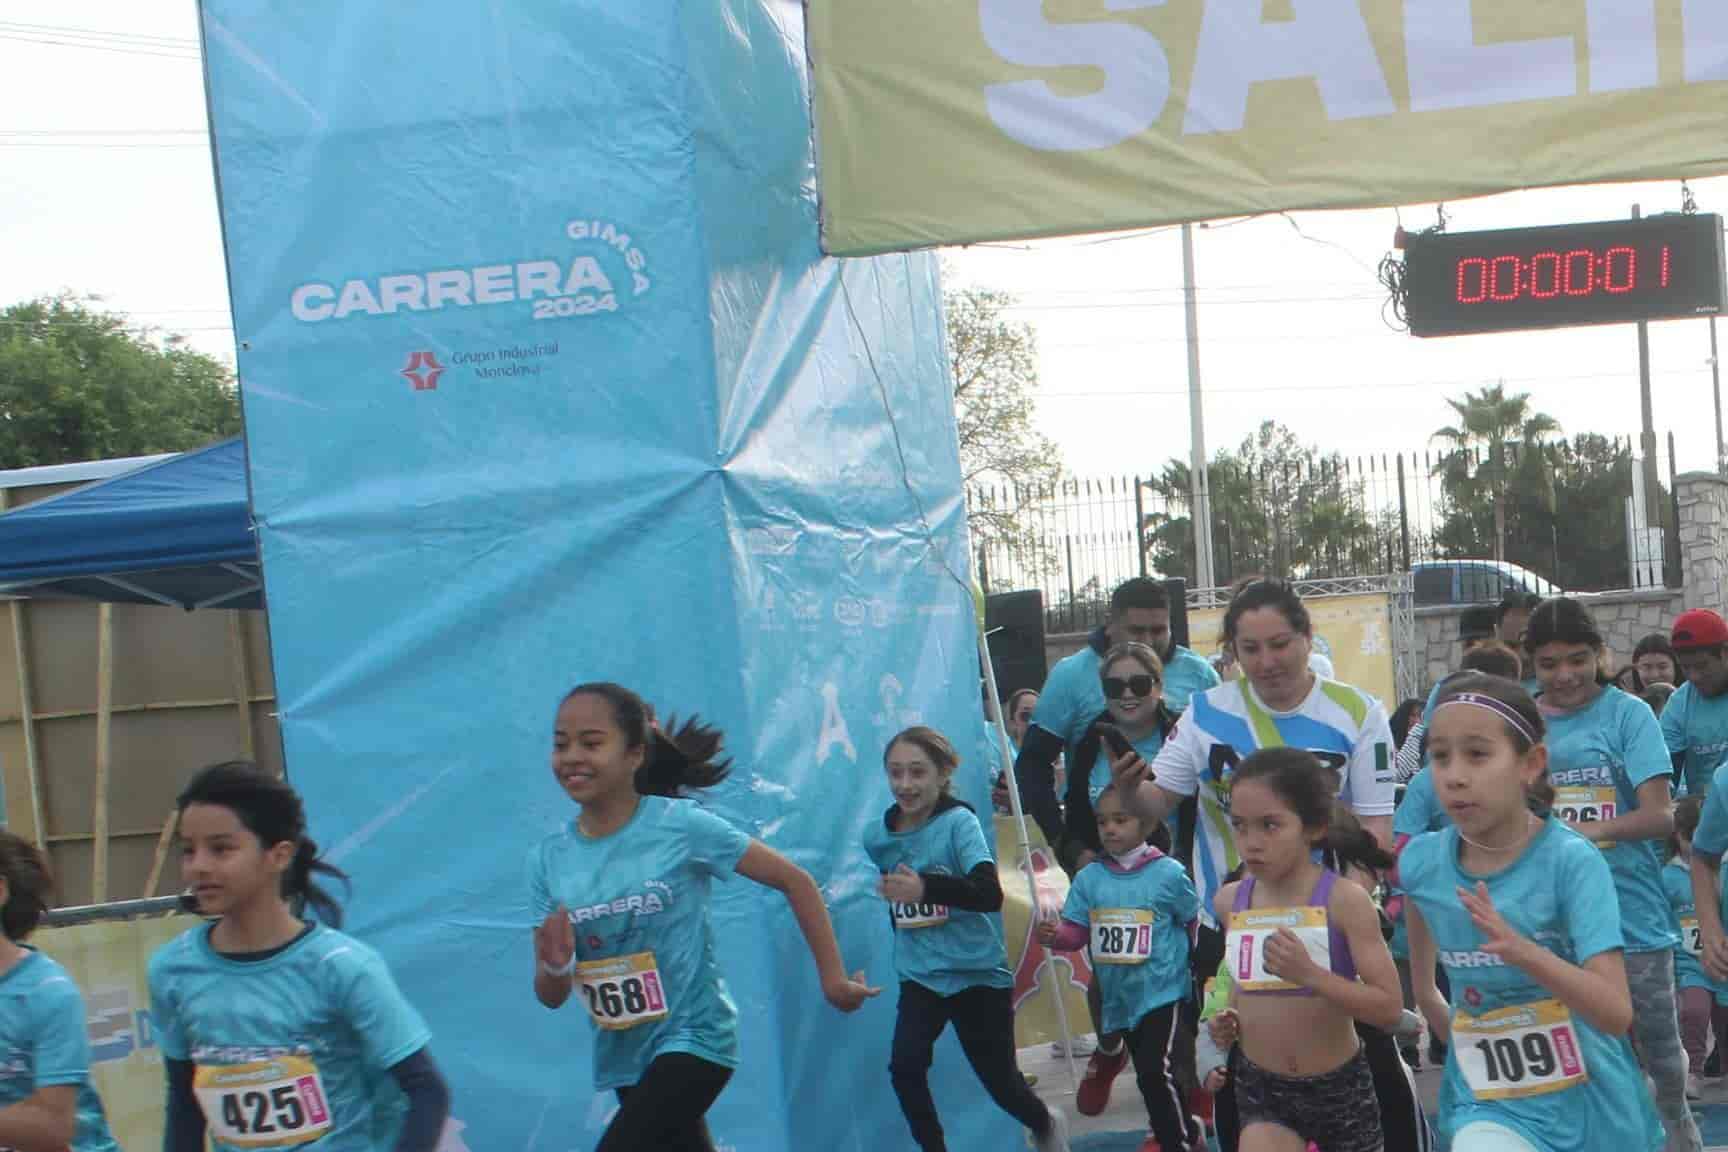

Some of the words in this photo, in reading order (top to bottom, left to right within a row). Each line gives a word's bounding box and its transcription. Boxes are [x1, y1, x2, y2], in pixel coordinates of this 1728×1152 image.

[566, 219, 650, 296] GIMSA
[1457, 245, 1672, 303] 00:00:01
[291, 256, 612, 322] CARRERA
[533, 292, 619, 320] 2024
[568, 893, 664, 924] ARRERA
[1099, 926, 1138, 954] 287
[1475, 1032, 1556, 1083] 109
[222, 1085, 306, 1134] 425
